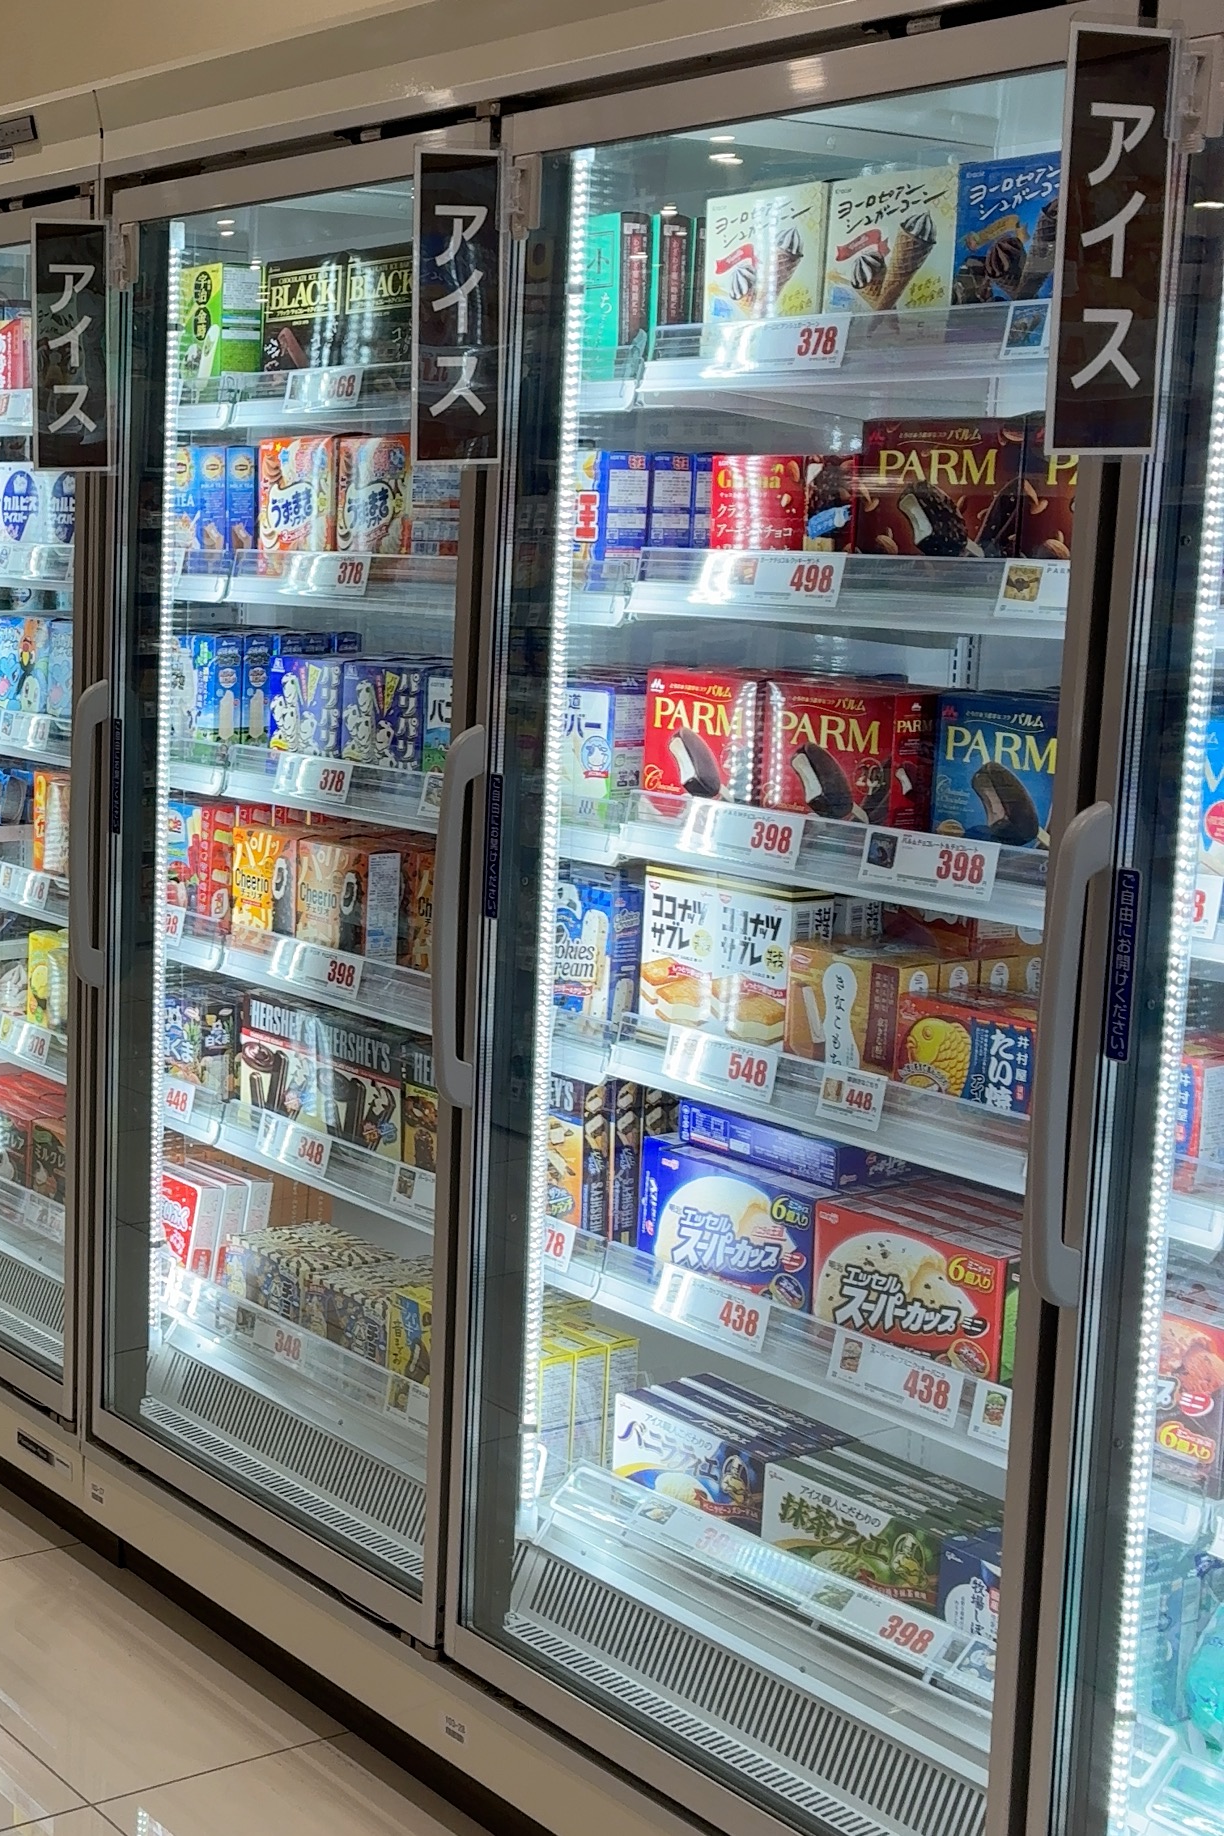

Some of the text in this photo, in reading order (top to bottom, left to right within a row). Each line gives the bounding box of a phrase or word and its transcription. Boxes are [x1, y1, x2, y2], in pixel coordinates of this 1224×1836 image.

[838, 184, 926, 219] ヨーロピアン
[970, 165, 1060, 205] ヨーロピアン
[846, 190, 948, 234] シュガーコーン
[1070, 103, 1155, 389] アイス
[270, 279, 337, 310] BLACK
[429, 205, 488, 417] アイス
[48, 264, 97, 433] アイス
[797, 326, 838, 356] 378
[947, 428, 983, 441] パルム
[877, 448, 998, 486] PARM
[4, 496, 38, 512] カルピス
[176, 496, 195, 507] TEA
[338, 561, 364, 585] 378
[790, 564, 834, 593] 498
[568, 694, 581, 710] 道
[706, 685, 732, 698] パルム
[834, 697, 866, 712] パルム
[653, 697, 743, 739] PARM
[780, 711, 880, 755] PARM
[1011, 713, 1044, 728] パルム
[946, 725, 1058, 775] PARM
[319, 768, 345, 793] 378
[751, 821, 793, 855] 398
[235, 868, 268, 894] Cheerio
[936, 849, 985, 884] 398
[300, 881, 336, 909] Cheerio
[652, 893, 709, 925] ココナッツ
[651, 922, 691, 951] サブレ
[722, 907, 782, 942] ココナッツ
[721, 936, 763, 967] サブレ
[1111, 873, 1136, 1059] ご自由にお開けください。
[327, 961, 355, 987] 398
[729, 1052, 768, 1087] 548
[1016, 1035, 1030, 1082] 井村屋
[166, 1088, 188, 1112] 448
[846, 1089, 873, 1110] 448
[298, 1136, 324, 1165] 348
[682, 1207, 732, 1233] エッセル
[671, 1226, 780, 1271] スーパーカップ
[842, 1266, 902, 1294] エッセル
[948, 1257, 993, 1291] 6個入り
[719, 1300, 759, 1337] 438
[836, 1287, 960, 1333] スーパーカップ
[963, 1317, 984, 1333] ミニ
[275, 1330, 301, 1360] 348
[903, 1368, 950, 1409] 438
[617, 1420, 721, 1482] バニラティエ
[800, 1484, 882, 1529] アイス職人こだわりの
[779, 1492, 889, 1564] 抹茶ティエ
[878, 1615, 935, 1655] 398
